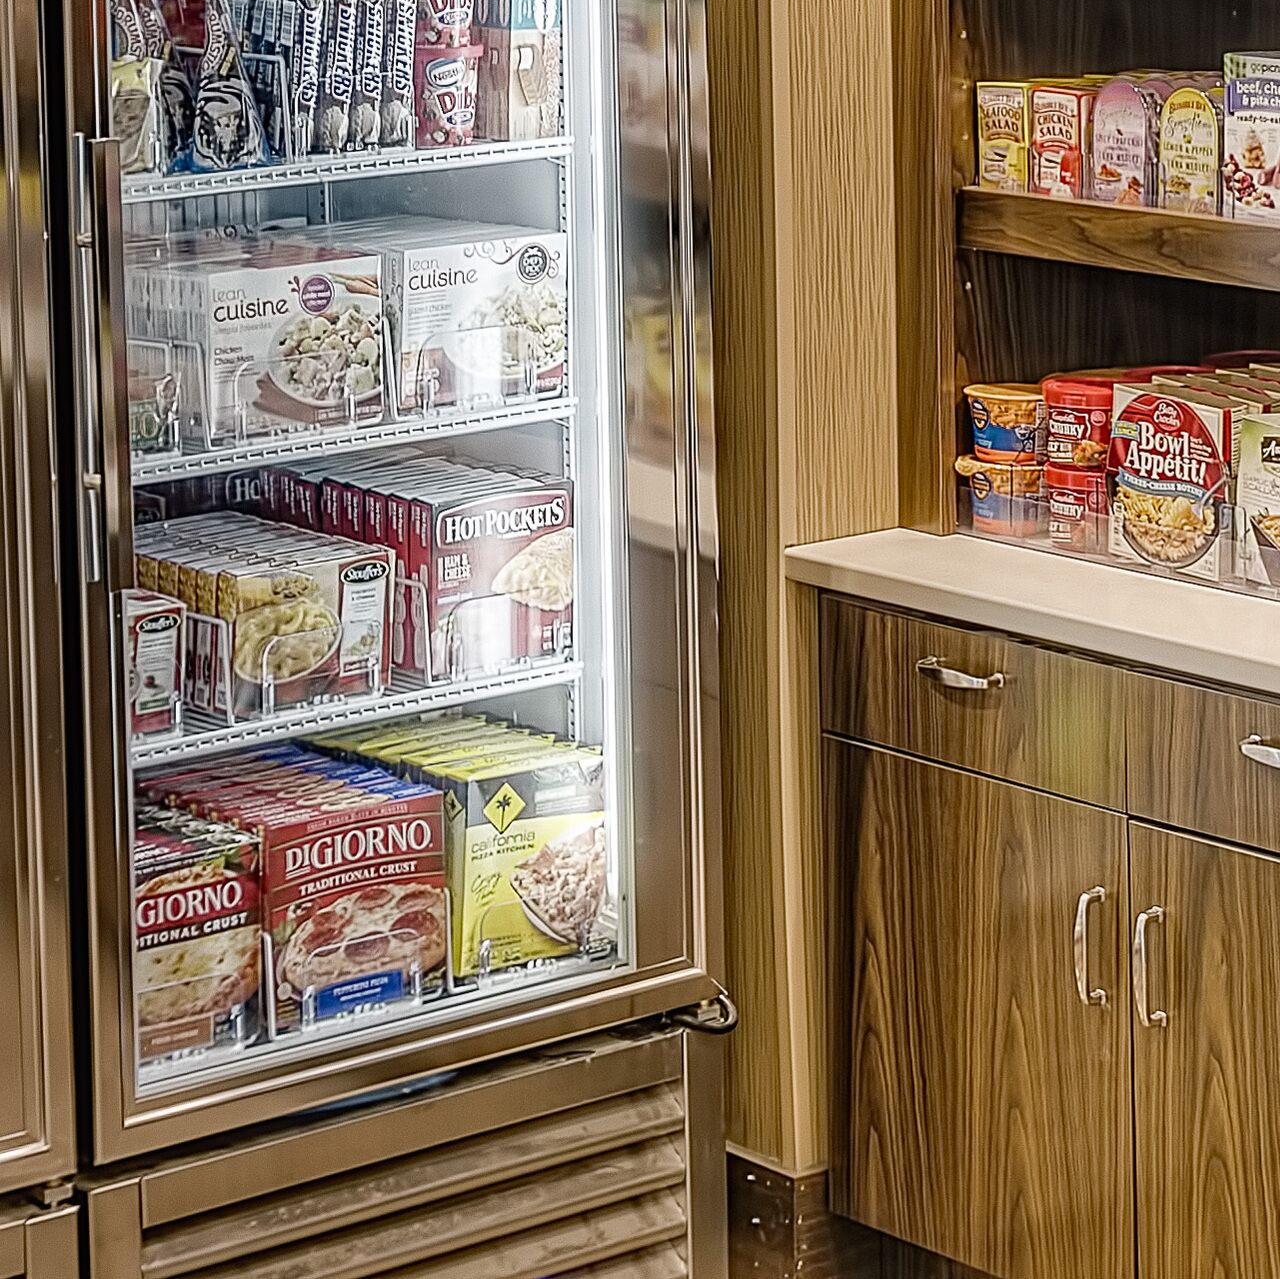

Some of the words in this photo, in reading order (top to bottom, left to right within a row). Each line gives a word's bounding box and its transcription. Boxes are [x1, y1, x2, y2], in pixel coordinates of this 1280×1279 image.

[1236, 81, 1262, 94] beef,
[1250, 96, 1271, 108] pita
[985, 119, 1019, 132] SALAD
[1037, 114, 1073, 129] CHICKEN
[1040, 126, 1072, 140] SALAD
[408, 258, 439, 272] lean
[409, 268, 478, 291] cuisine
[212, 288, 247, 302] lean
[213, 298, 289, 322] cuisine
[1138, 422, 1189, 458] Bowl
[1124, 441, 1206, 485] Appétit!
[445, 514, 485, 544] HOT
[484, 497, 565, 536] POCKETS
[471, 830, 536, 854] california
[471, 851, 494, 862] PIZZA
[496, 843, 536, 855] KITCHEN
[299, 868, 378, 896] TRADITIONAL
[380, 861, 418, 875] CRUST
[203, 912, 248, 933] CRUST
